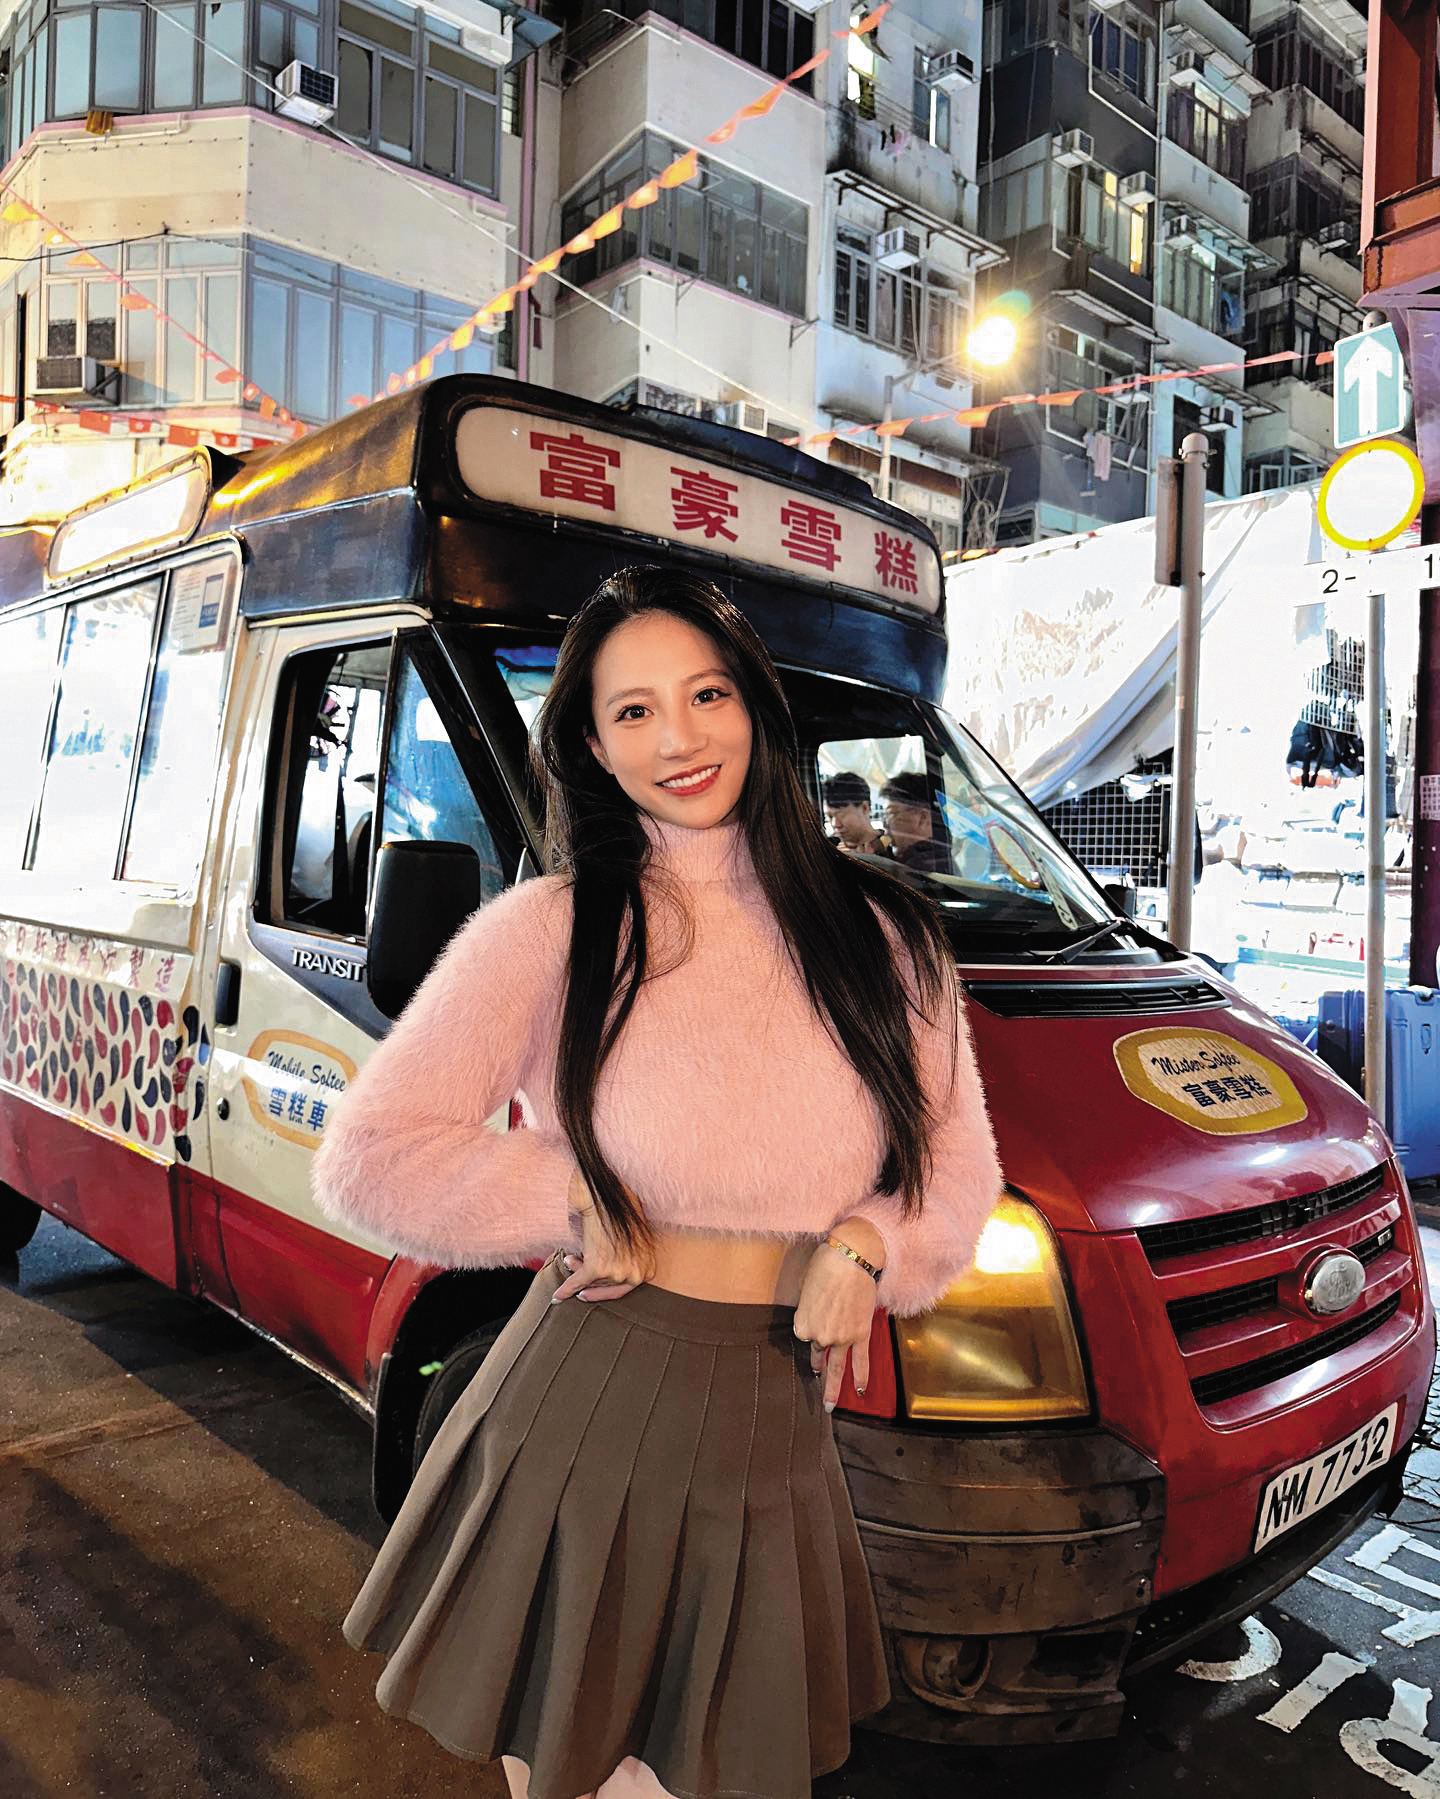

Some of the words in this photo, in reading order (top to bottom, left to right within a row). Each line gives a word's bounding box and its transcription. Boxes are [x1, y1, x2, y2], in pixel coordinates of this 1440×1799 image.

[529, 431, 919, 595] 富豪雪糕
[1423, 553, 1440, 579] 1
[291, 948, 365, 982] TRANSIT
[269, 1087, 329, 1131] 雪糕車
[1181, 1074, 1272, 1108] 富豪雪糕
[1263, 1466, 1314, 1539] NM
[1314, 1416, 1389, 1505] 7732
